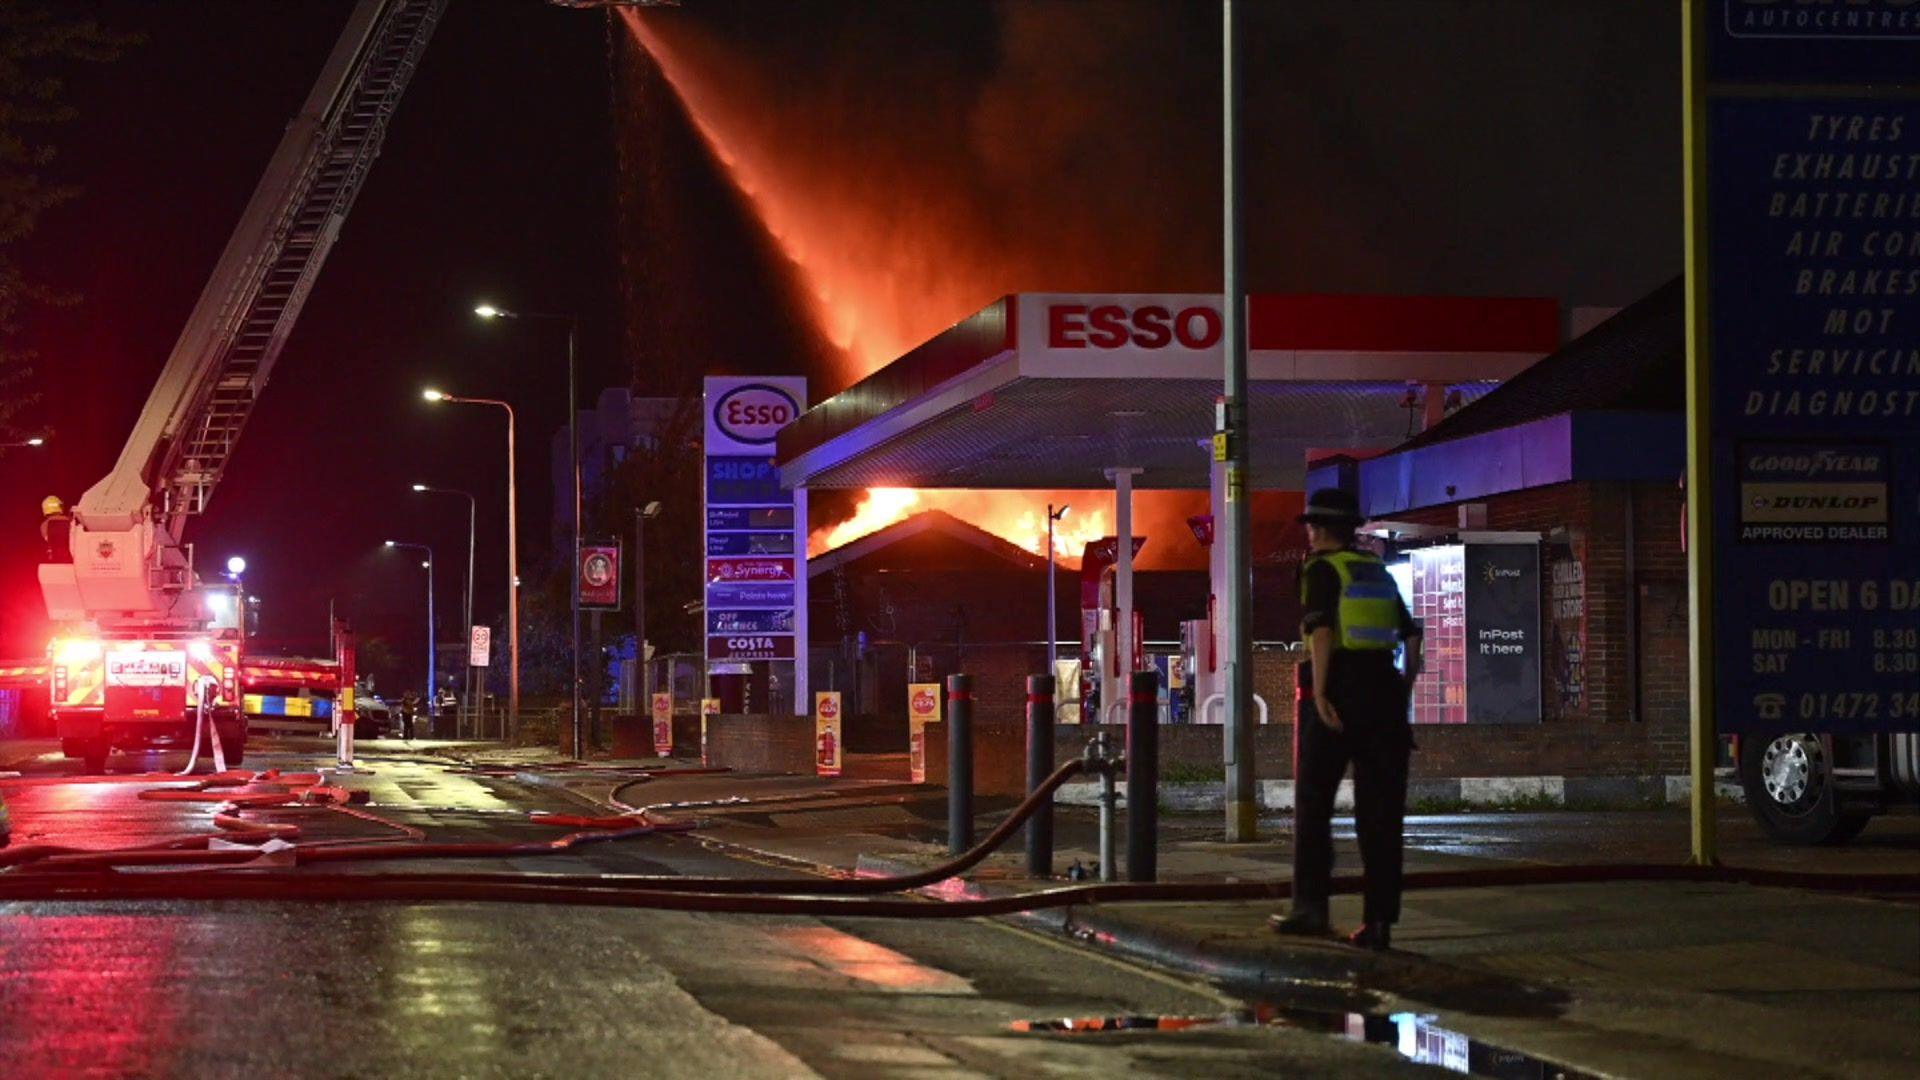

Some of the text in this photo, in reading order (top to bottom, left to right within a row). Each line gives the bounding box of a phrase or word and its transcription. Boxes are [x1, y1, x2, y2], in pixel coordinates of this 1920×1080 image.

[1744, 10, 1920, 28] AUTOCENTRES
[1808, 115, 1904, 141] TYRES
[1772, 153, 1920, 180] EXHAUST
[1768, 192, 1920, 219] BATTERIE
[1785, 231, 1843, 257] AIR
[1795, 269, 1920, 295] BRAKES
[1049, 305, 1222, 350] ESSO
[1823, 309, 1895, 335] MOT
[727, 401, 787, 424] Esso
[1745, 391, 1920, 416] DIAGNOST
[1772, 496, 1878, 508] DUNLOP
[1742, 527, 1888, 539] APPROVED DEALER
[1768, 580, 1849, 611] OPEN
[1860, 580, 1879, 611] 6
[727, 637, 775, 650] COSTA
[1479, 629, 1524, 640] InPost
[1752, 629, 1796, 649] MON
[1818, 629, 1850, 649] FRI
[1873, 629, 1917, 649] 8.30
[1492, 643, 1524, 655] here
[1752, 653, 1918, 673] SAT 8.30
[1800, 692, 1879, 718] 01472
